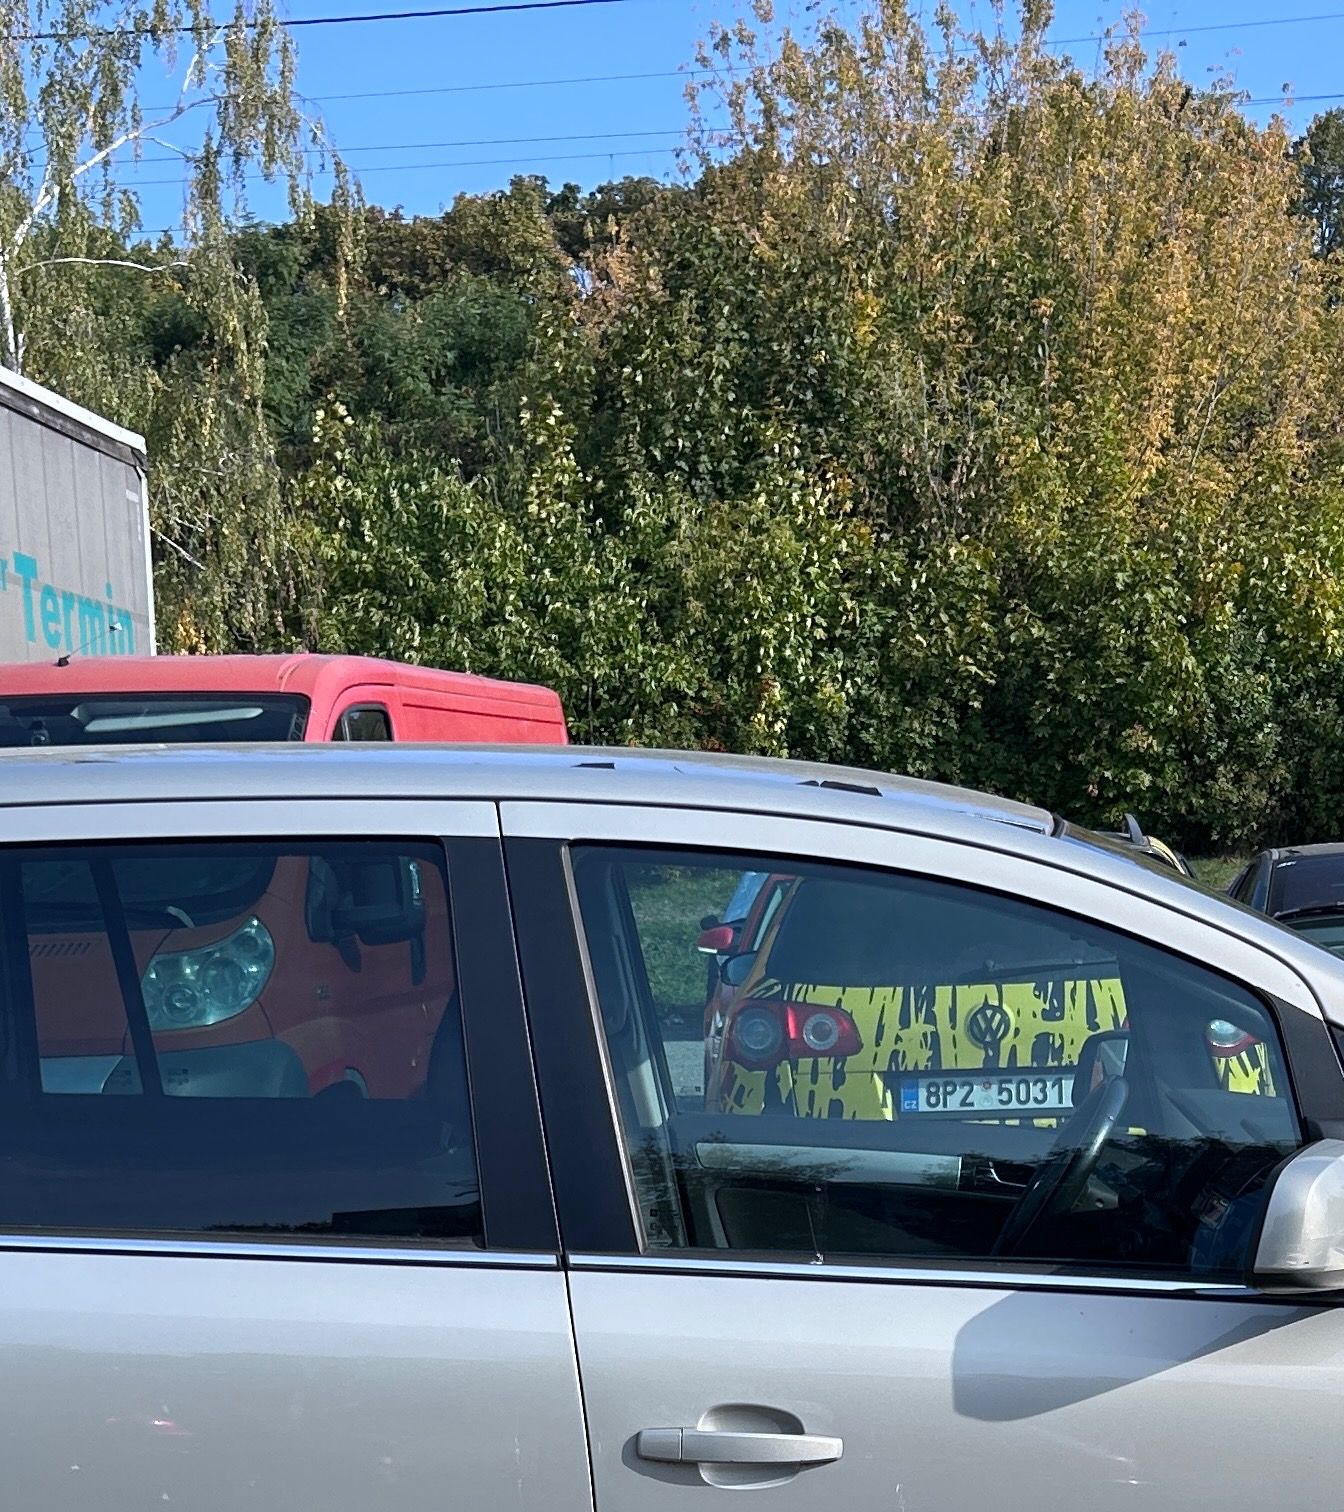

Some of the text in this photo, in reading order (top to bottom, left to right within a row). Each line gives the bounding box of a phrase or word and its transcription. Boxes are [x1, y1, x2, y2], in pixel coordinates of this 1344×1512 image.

[13, 551, 135, 656] Termin
[904, 1101, 918, 1110] CZ
[925, 1077, 1065, 1109] 8P2 5031
